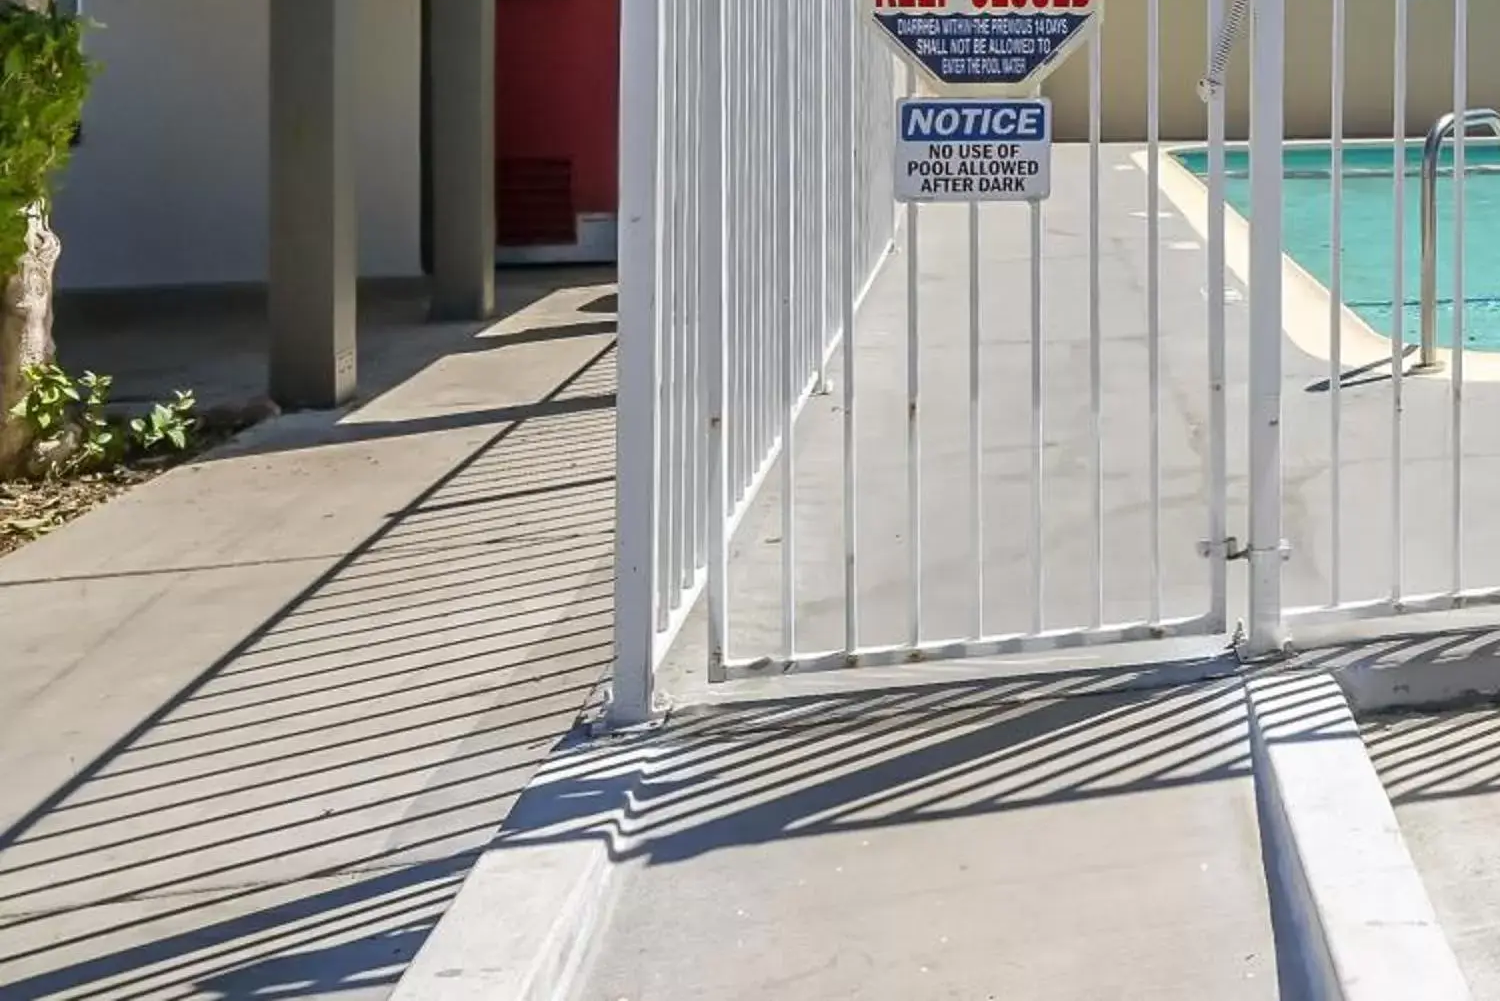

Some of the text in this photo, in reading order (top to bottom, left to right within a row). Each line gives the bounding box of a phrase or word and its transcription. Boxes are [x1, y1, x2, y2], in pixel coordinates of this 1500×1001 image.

[897, 18, 940, 35] DIARRHEA
[992, 18, 1033, 35] PREVIOUS
[1035, 18, 1045, 35] 14
[1046, 18, 1068, 35] DAYS
[917, 38, 1051, 55] SHALL NOT BE ALLOWED TO
[942, 58, 1026, 74] ENTER THE POOL WATER
[907, 108, 1041, 136] NOTICE
[929, 144, 1021, 159] NO USE OF
[908, 160, 1039, 176] POOL ALLOWED
[921, 177, 1026, 192] AFTER DARK
